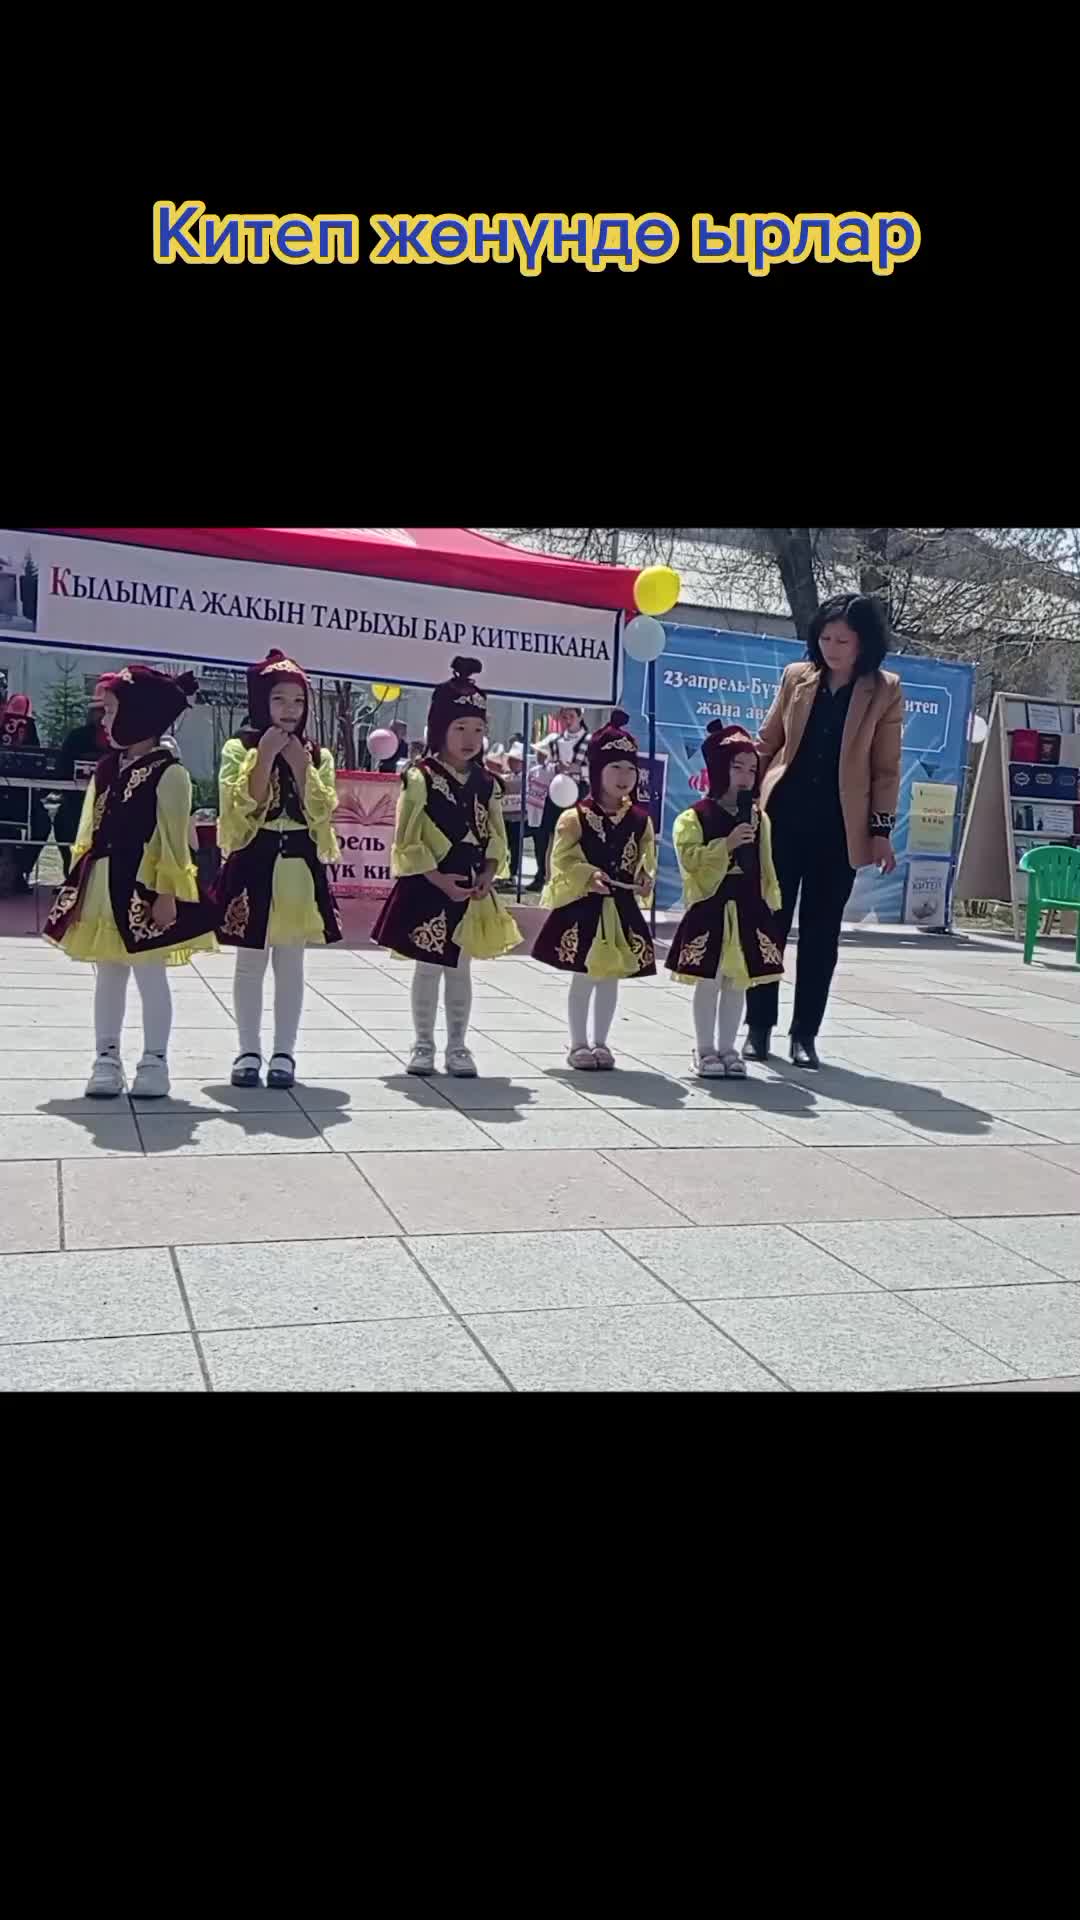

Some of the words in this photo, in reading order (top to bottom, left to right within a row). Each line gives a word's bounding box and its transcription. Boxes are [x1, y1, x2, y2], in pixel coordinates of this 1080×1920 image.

[50, 565, 196, 612] КЫЛЫМГА
[200, 589, 305, 628] ЖАКЫН
[311, 604, 418, 640] ТАРЫХЫ
[422, 618, 466, 644] БАР
[472, 625, 610, 661] КИТЕПКАНА
[695, 701, 741, 718] жана
[903, 699, 939, 715] итеп
